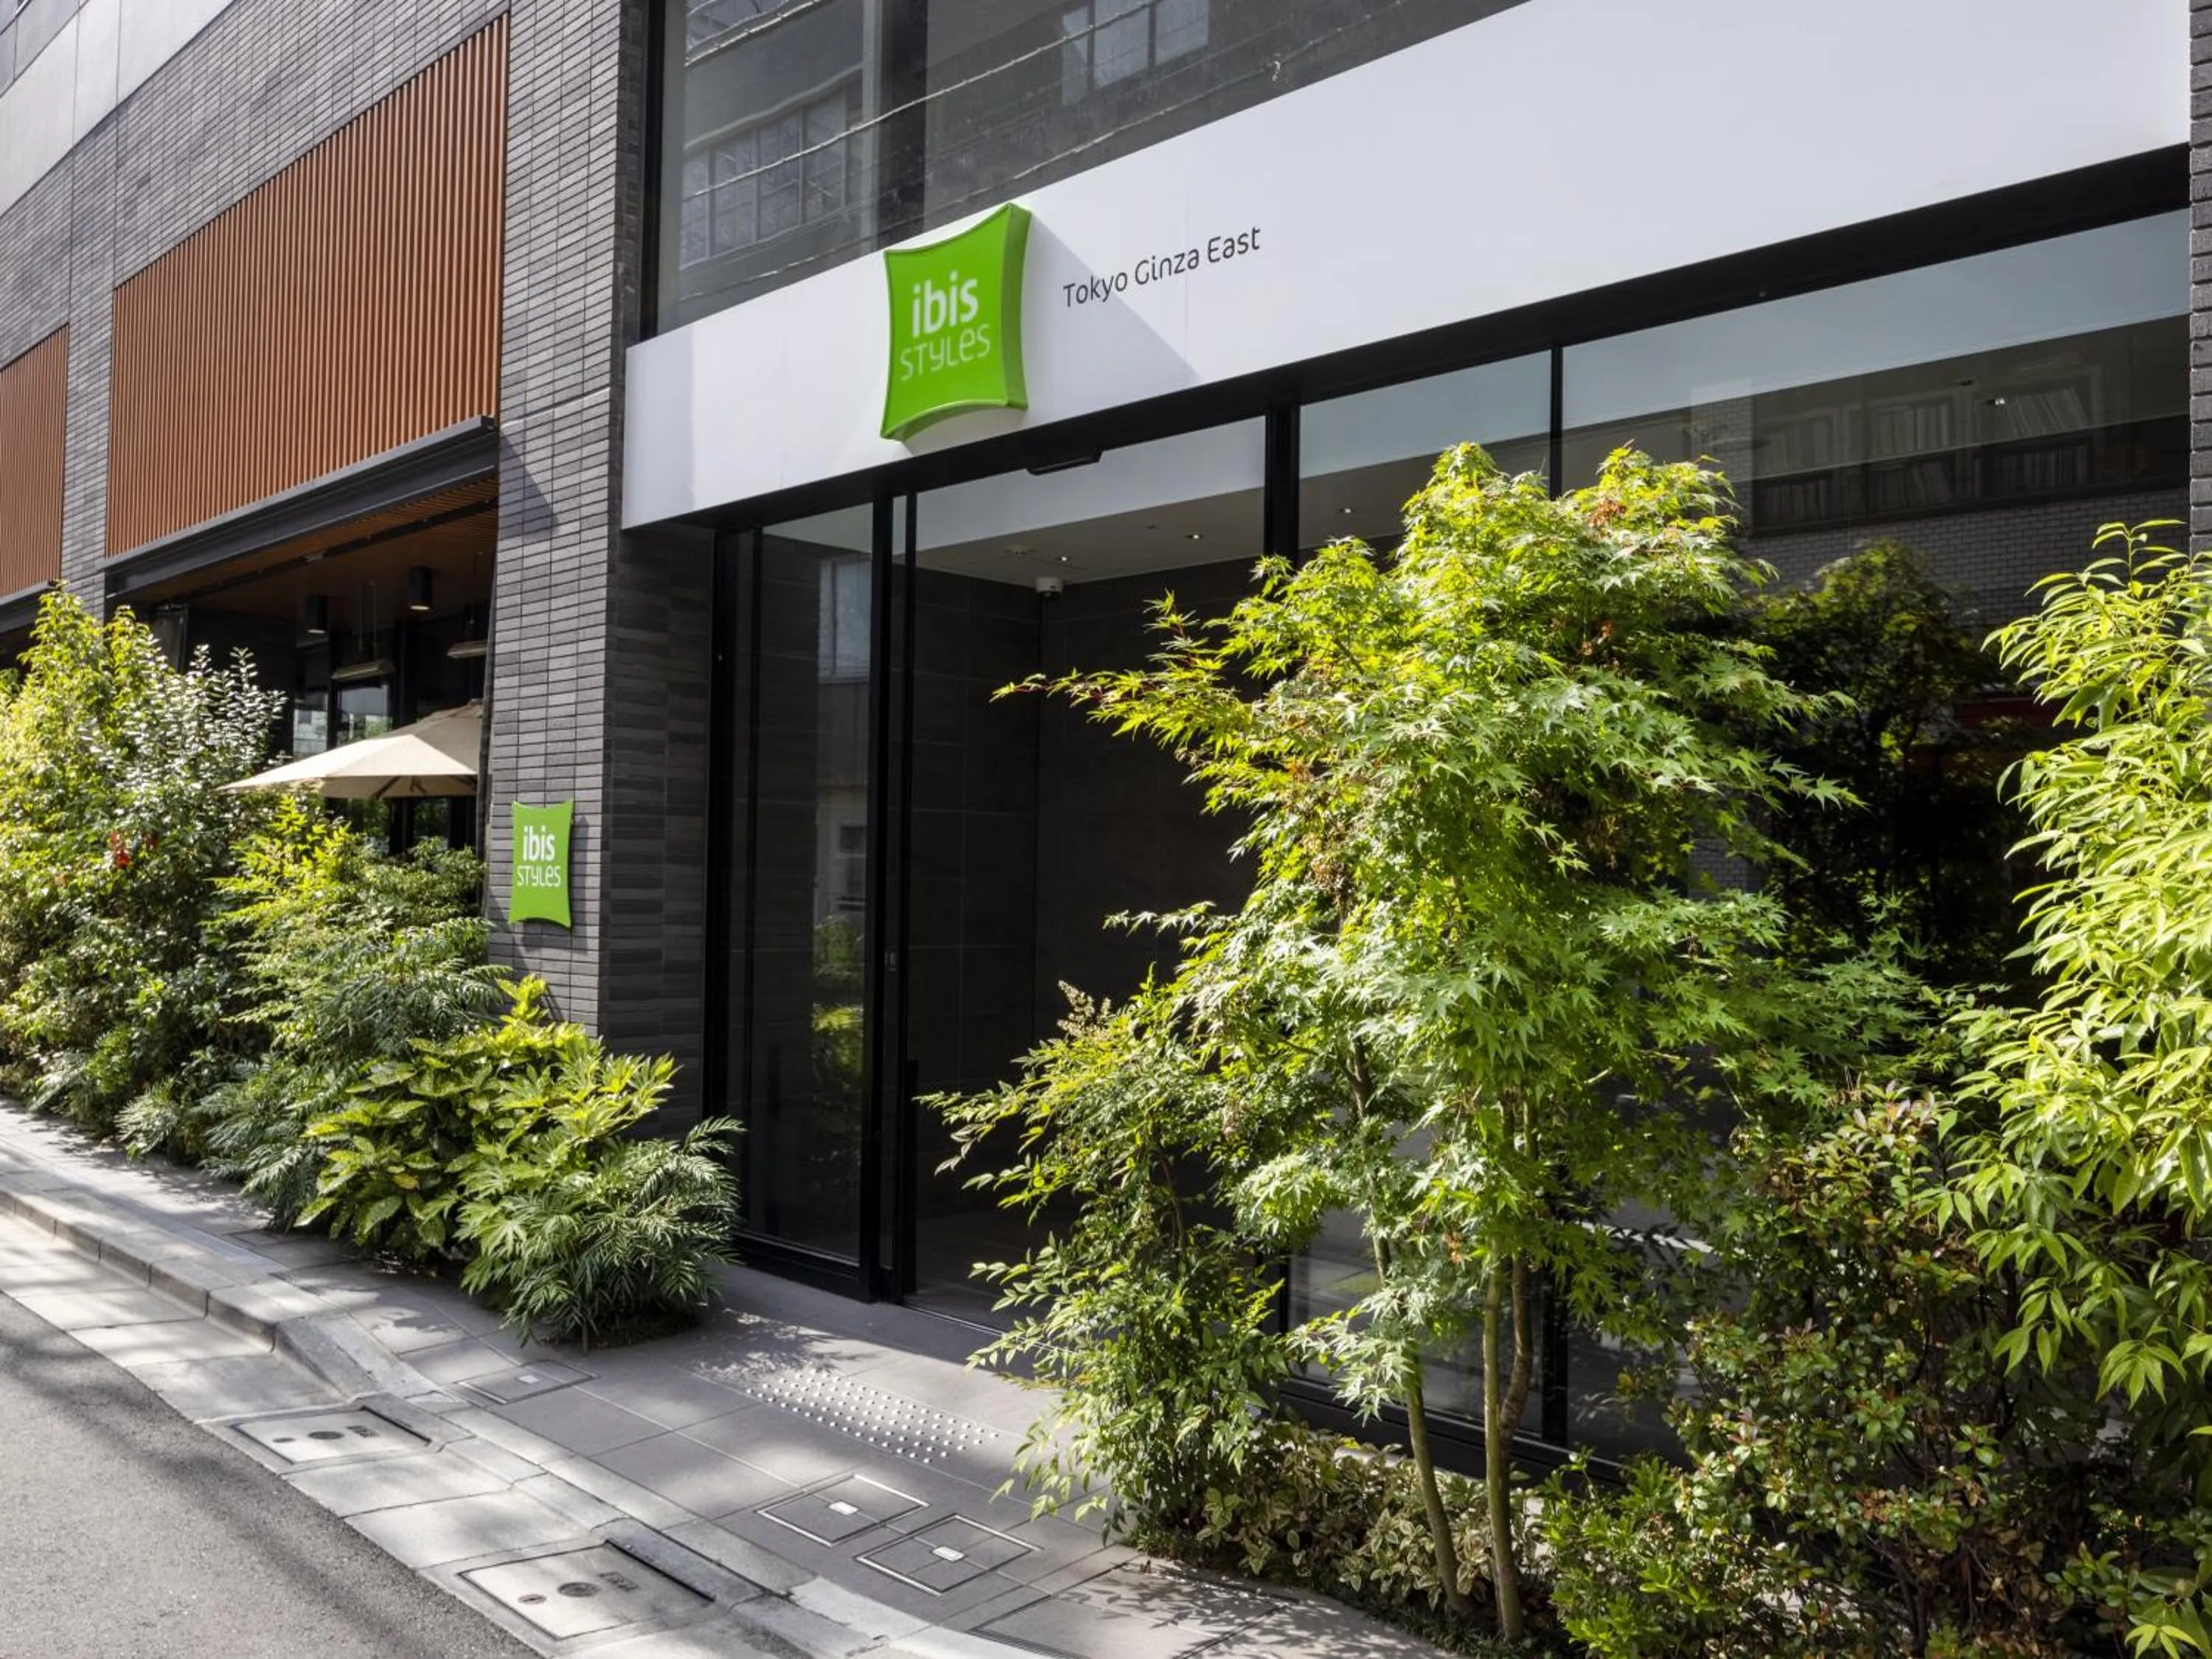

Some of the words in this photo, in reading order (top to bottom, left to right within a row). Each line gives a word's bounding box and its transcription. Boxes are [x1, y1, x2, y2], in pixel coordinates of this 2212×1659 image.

[1062, 271, 1128, 307] Tokyo
[1134, 248, 1200, 285] Ginza
[1207, 226, 1261, 263] East
[911, 270, 979, 338] ibis
[523, 824, 556, 862] ibis
